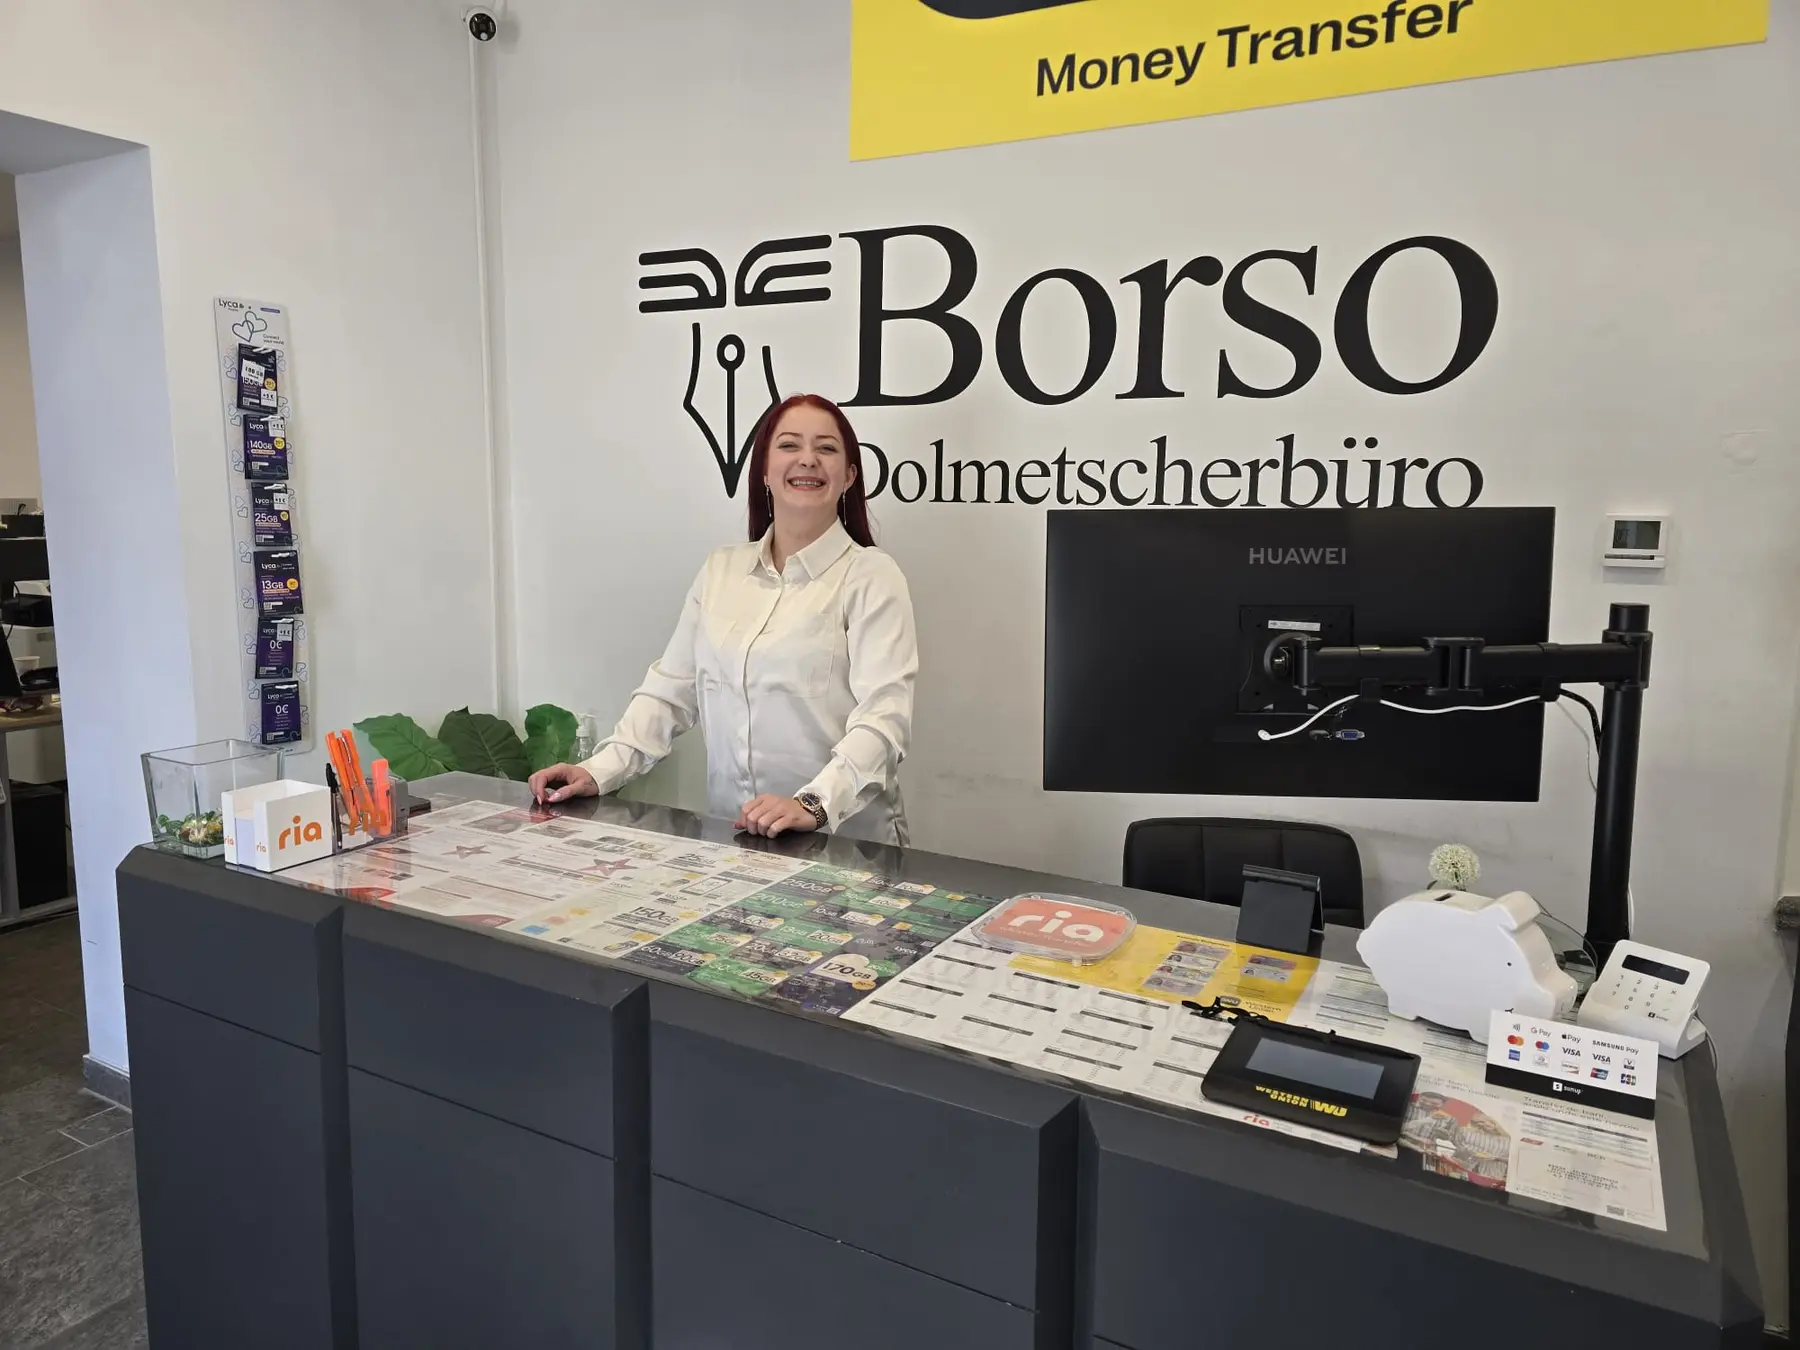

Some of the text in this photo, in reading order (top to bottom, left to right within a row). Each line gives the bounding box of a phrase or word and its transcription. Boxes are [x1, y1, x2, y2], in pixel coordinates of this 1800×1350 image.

[1036, 0, 1474, 97] Money Transfer
[219, 298, 238, 308] Lyca
[837, 224, 1499, 407] Borso
[249, 422, 263, 430] Lyca
[250, 440, 272, 449] 140GB
[858, 433, 1484, 509] Dolmetscherbüro
[255, 497, 269, 505] Lyca
[255, 513, 278, 522] 25GB
[1249, 547, 1346, 565] HUAWEI
[262, 580, 284, 589] 13GB
[278, 815, 322, 850] ria
[224, 835, 234, 846] ria
[256, 842, 266, 853] ria
[1008, 910, 1104, 943] ria
[822, 962, 872, 980] 170GB
[1539, 1028, 1551, 1038] Pay
[1567, 1034, 1581, 1043] Pay
[1562, 1047, 1581, 1057] VISA
[1592, 1040, 1639, 1055] SAMSUNG Pay
[1592, 1053, 1611, 1063] VISA
[1255, 1085, 1309, 1104] WESTERN
[1270, 1093, 1308, 1108] UNION
[1313, 1100, 1348, 1117] WU
[1243, 1114, 1270, 1126] ria
